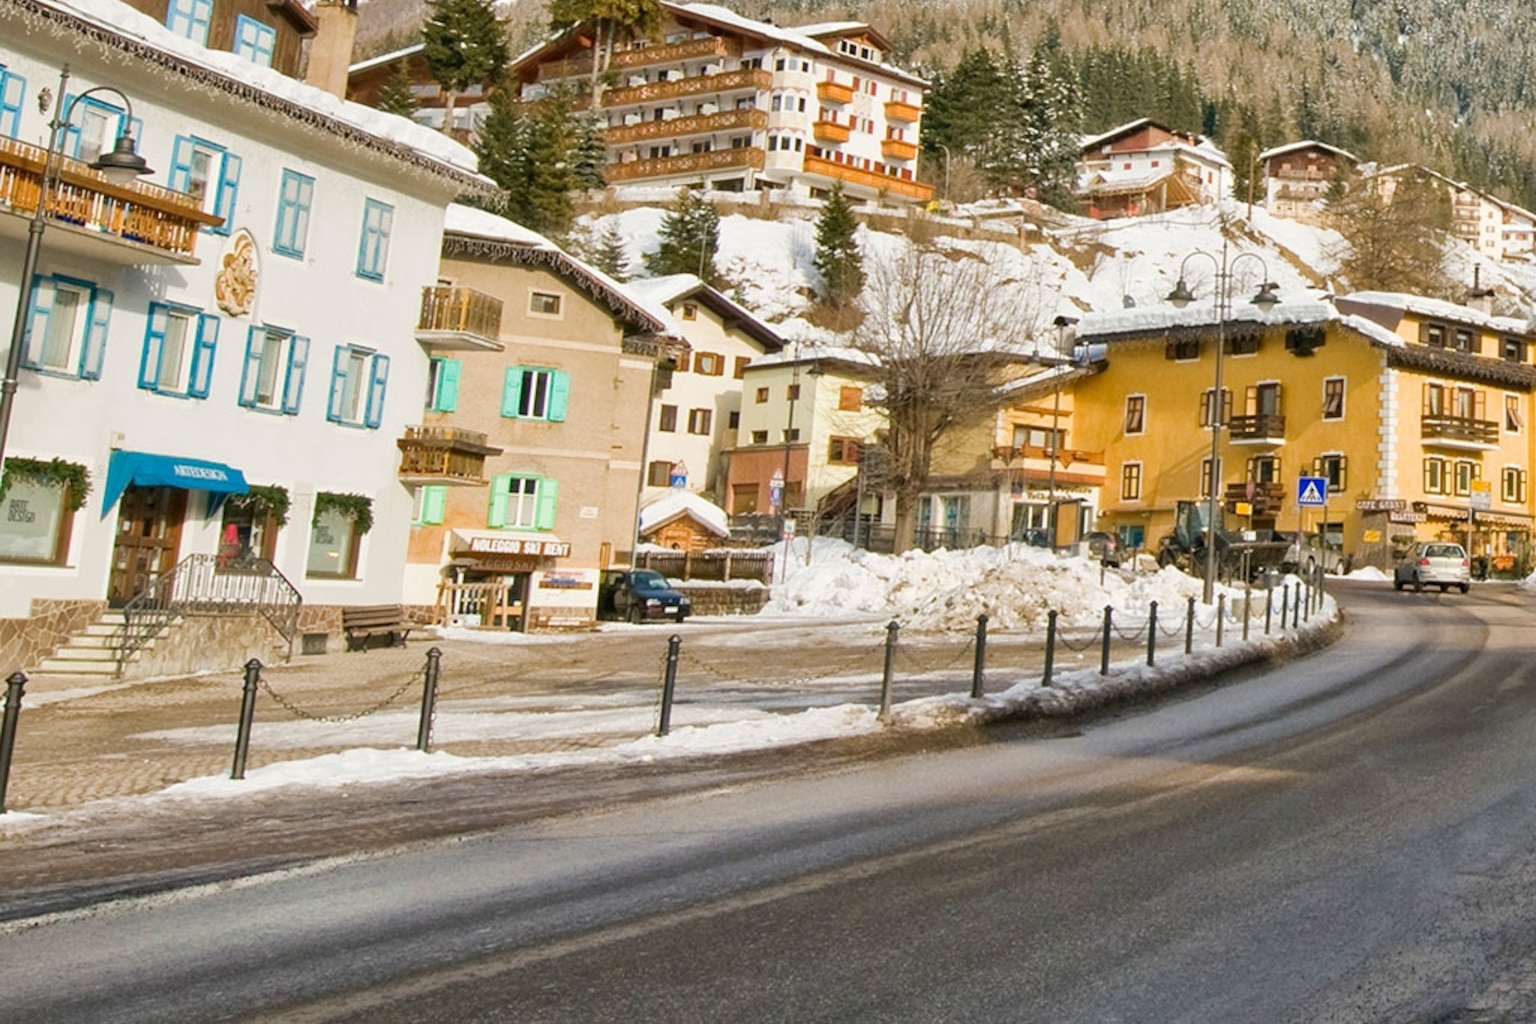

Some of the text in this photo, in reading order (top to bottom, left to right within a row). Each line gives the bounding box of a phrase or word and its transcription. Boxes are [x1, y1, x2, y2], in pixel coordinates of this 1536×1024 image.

[471, 538, 570, 556] NOLEGGIO SKI RENT
